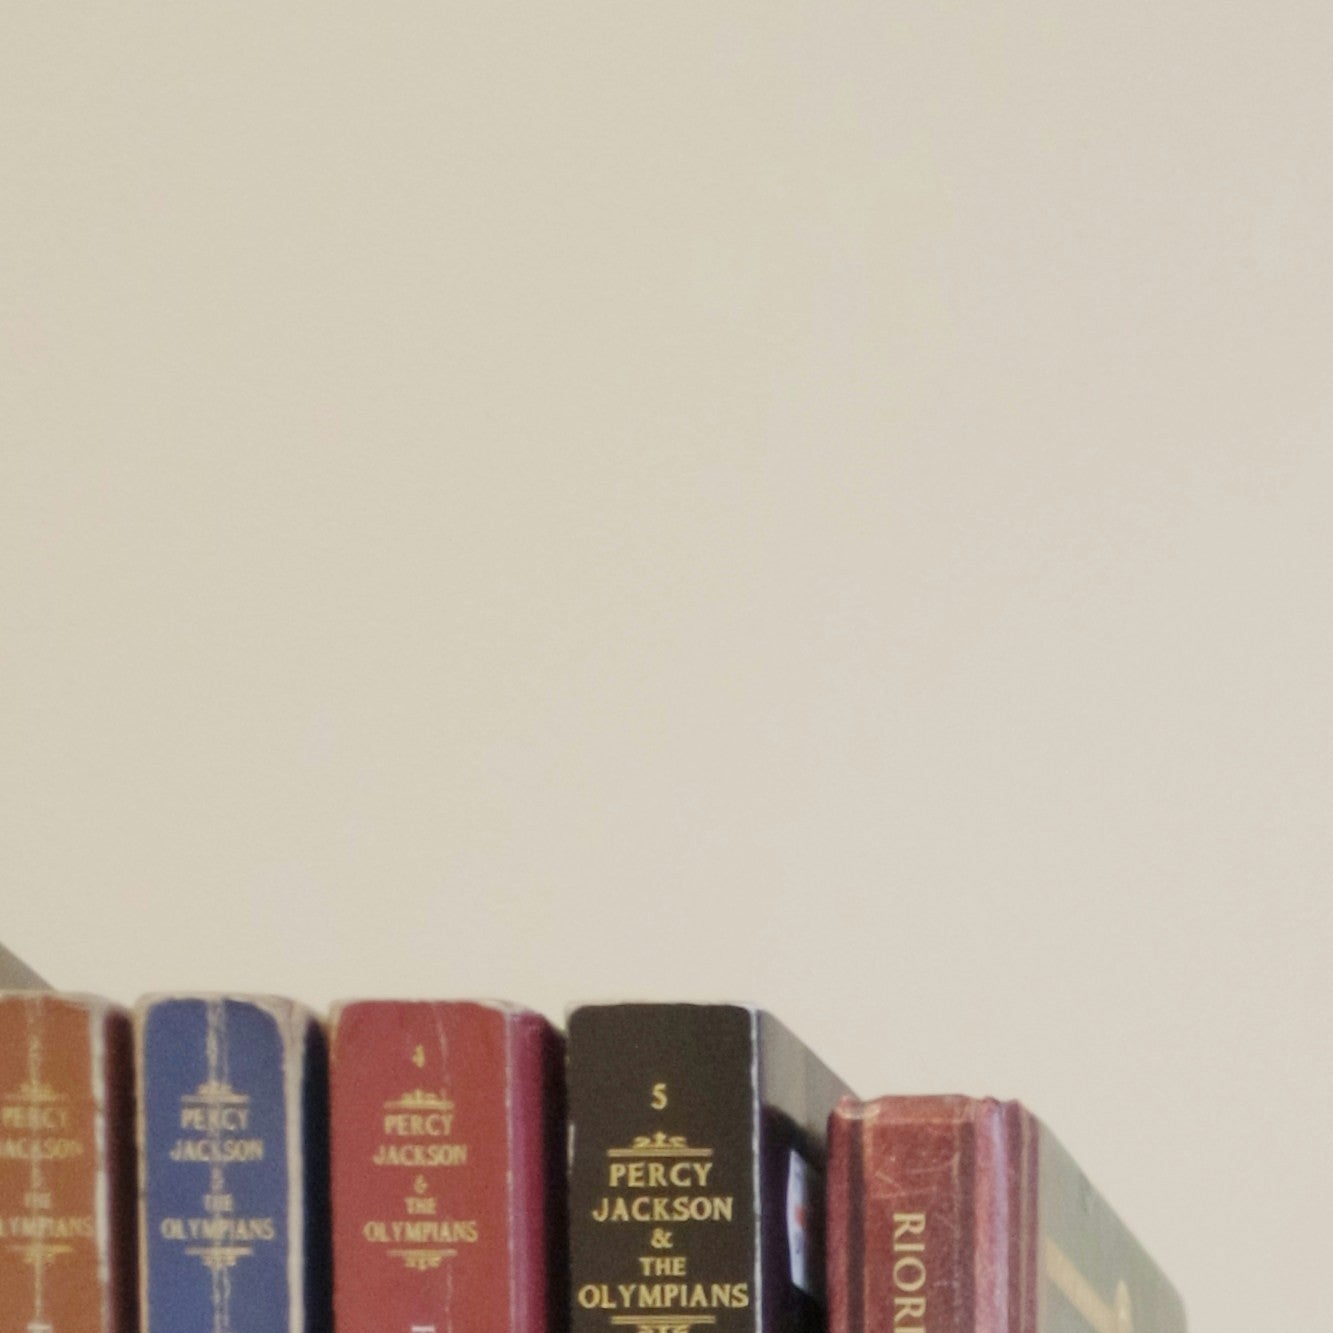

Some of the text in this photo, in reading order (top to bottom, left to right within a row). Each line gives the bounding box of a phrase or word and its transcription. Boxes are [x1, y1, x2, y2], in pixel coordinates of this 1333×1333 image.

[650, 1083, 669, 1110] 5
[383, 1113, 454, 1136] PERCY
[372, 1144, 468, 1166] JACKSON
[608, 1162, 713, 1187] PERCY
[403, 1197, 437, 1215] THE
[592, 1196, 734, 1222] JACKSON
[160, 1217, 275, 1240] OLYMPIANS
[362, 1219, 480, 1243] OLYMPIANS
[650, 1227, 674, 1249] &
[638, 1256, 688, 1277] THE
[577, 1283, 750, 1308] OLYMPIANS
